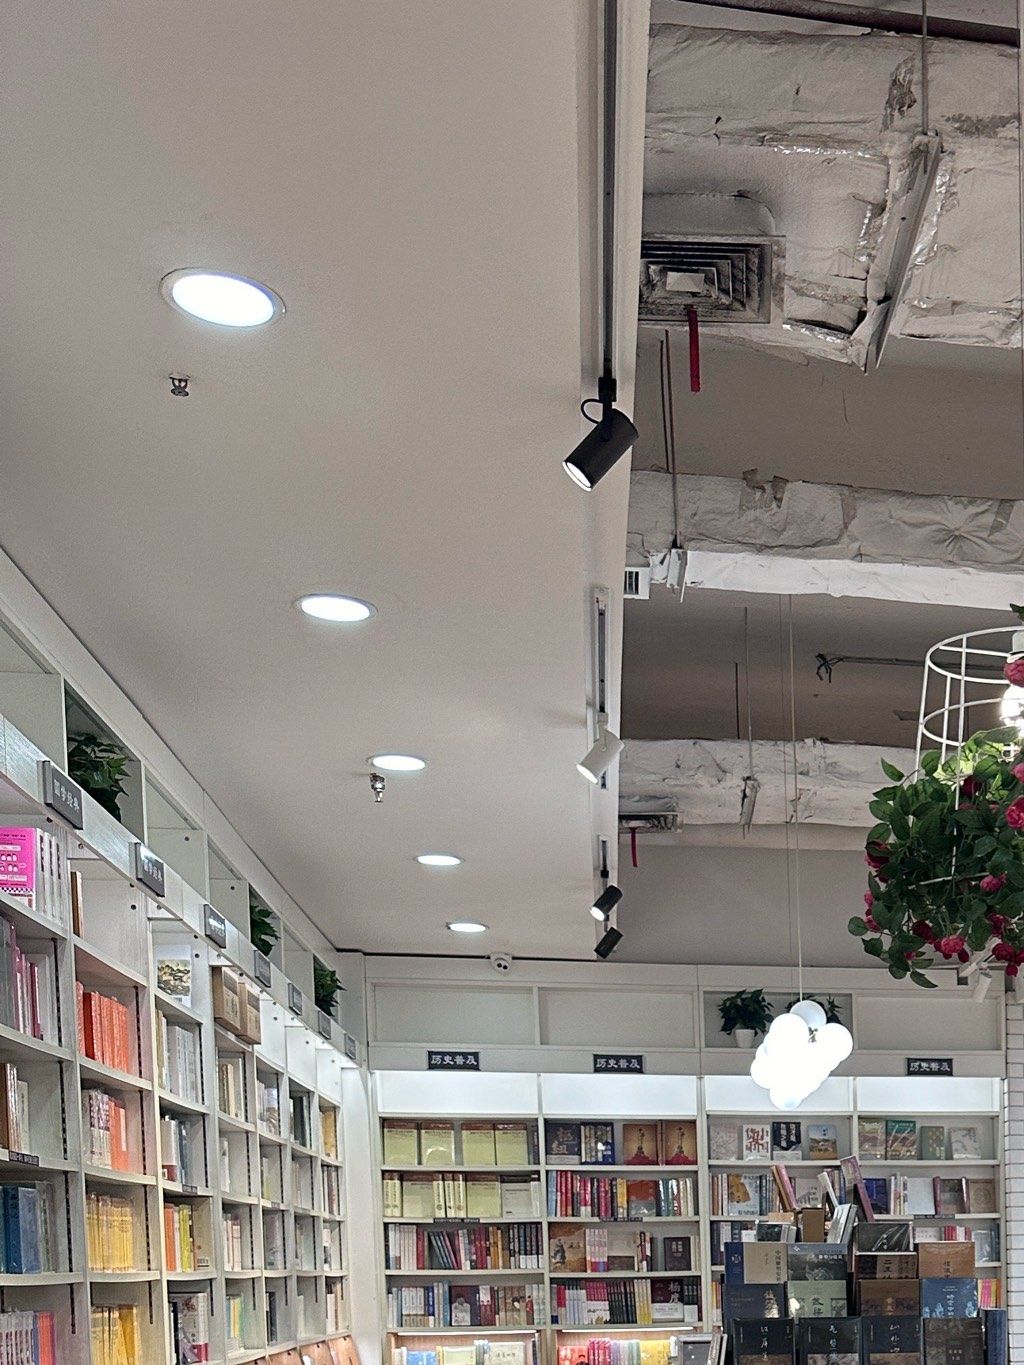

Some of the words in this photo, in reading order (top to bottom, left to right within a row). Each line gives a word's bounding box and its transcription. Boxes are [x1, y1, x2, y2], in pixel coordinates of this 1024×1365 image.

[430, 1054, 478, 1066] 历史普及
[595, 1058, 641, 1069] 历史普及
[909, 1061, 951, 1072] 历史普及
